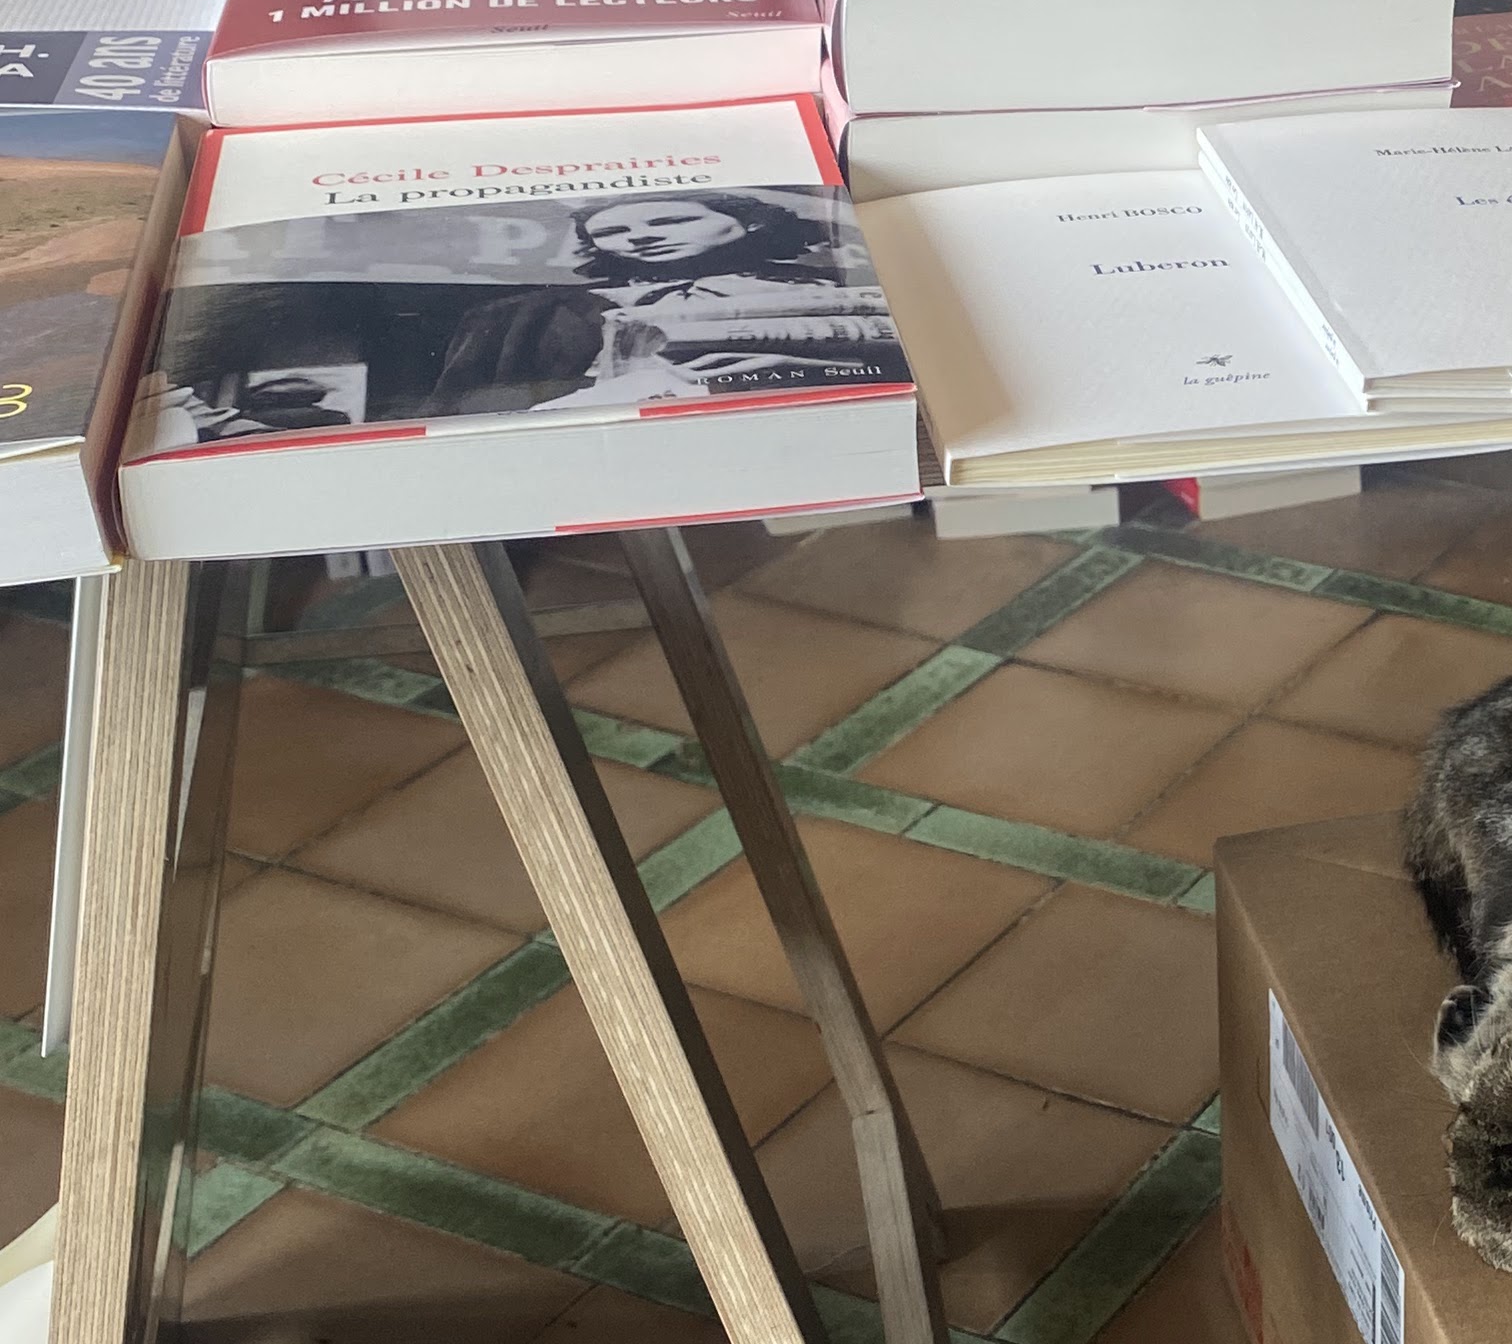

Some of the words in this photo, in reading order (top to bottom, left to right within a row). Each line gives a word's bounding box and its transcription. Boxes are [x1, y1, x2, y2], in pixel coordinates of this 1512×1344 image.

[268, 9, 285, 24] 1
[87, 35, 163, 69] ans
[74, 74, 147, 101] 40
[149, 88, 183, 103] de
[1373, 145, 1492, 157] Marie-Hélène
[311, 165, 451, 187] Cécile
[472, 152, 722, 180] Desprairies
[324, 189, 380, 207] La
[399, 172, 713, 204] propagandiste
[1455, 194, 1499, 207] Les
[1055, 210, 1119, 224] Henri
[1122, 205, 1204, 219] BOSCO
[1088, 257, 1231, 278] Luberon
[696, 369, 807, 387] ROMAN
[824, 364, 883, 378] Seuil
[1205, 370, 1272, 387] guêpine
